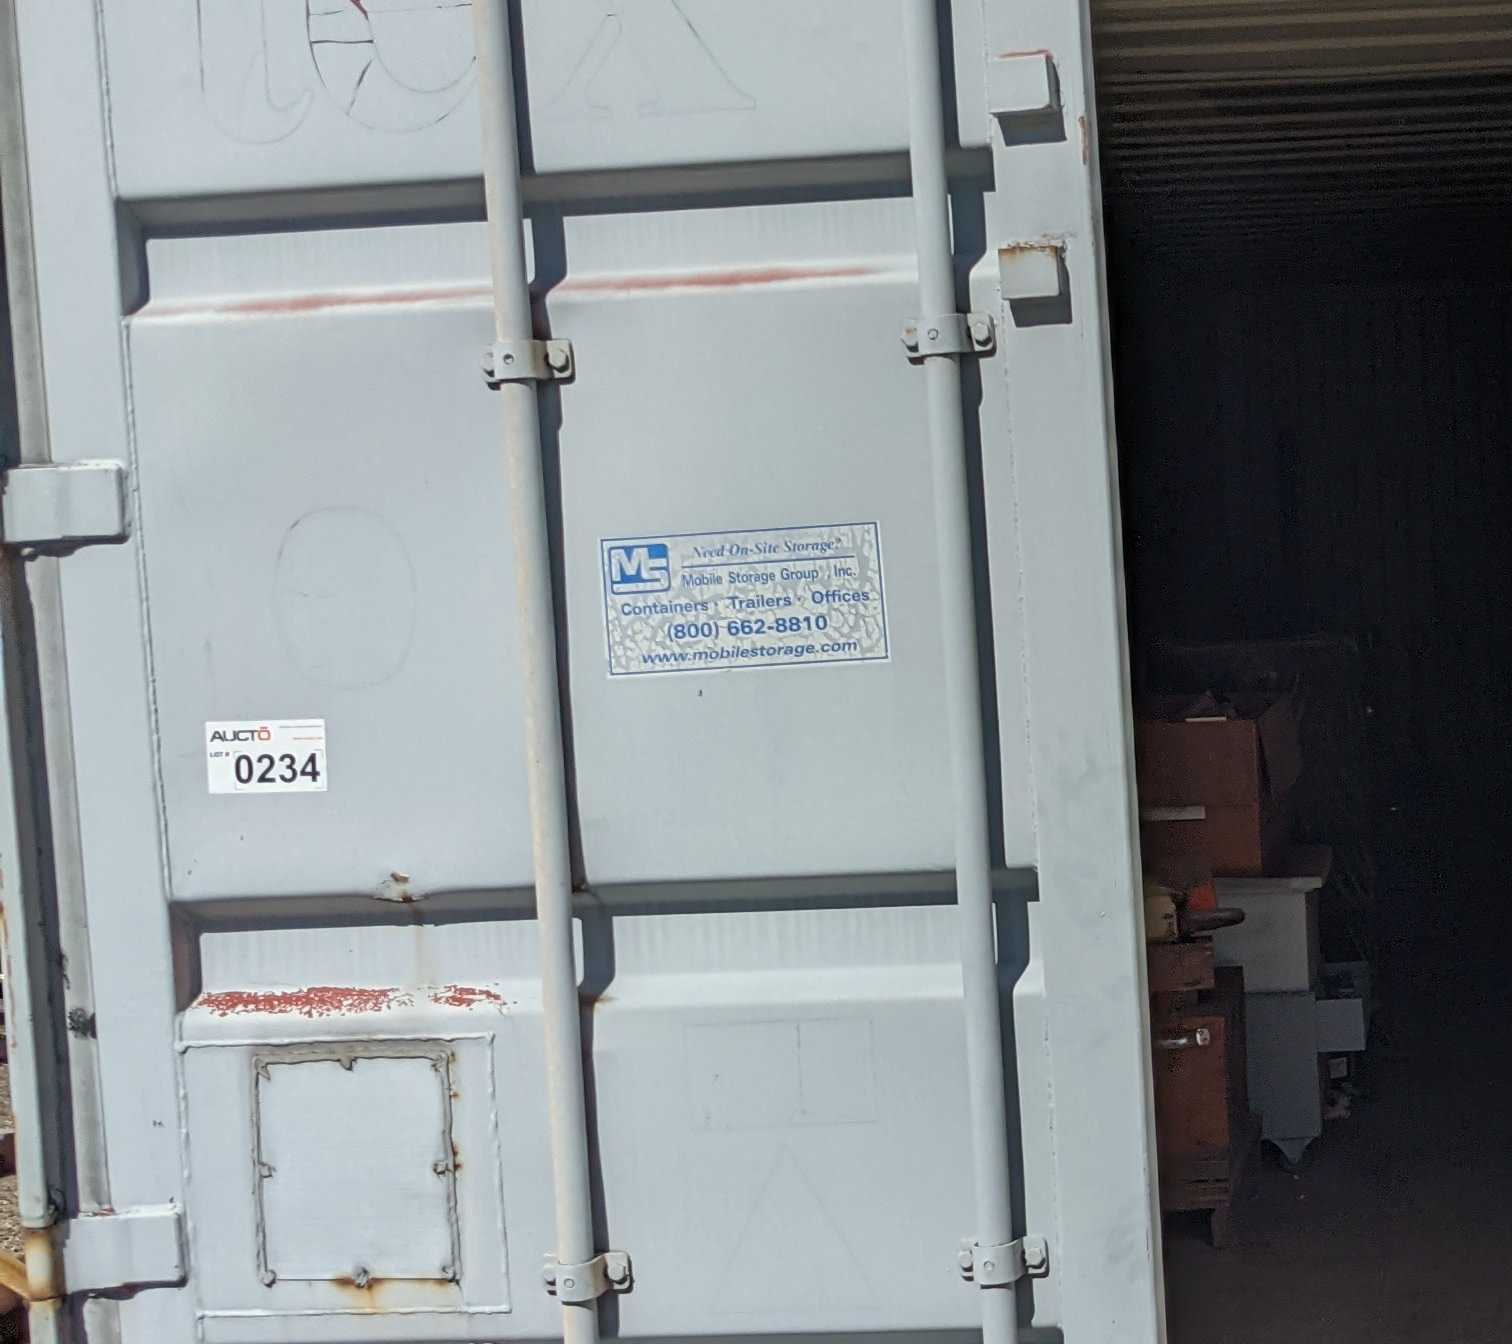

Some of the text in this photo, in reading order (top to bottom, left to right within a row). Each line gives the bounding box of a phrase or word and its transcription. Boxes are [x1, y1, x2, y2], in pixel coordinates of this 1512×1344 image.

[692, 543, 724, 558] Need
[728, 541, 780, 556] On-Site
[681, 573, 723, 587] Mobile
[728, 569, 777, 584] Storage
[833, 564, 857, 578] Inc.
[621, 590, 870, 616] Containers Trailers Offices
[667, 614, 828, 642] (800) 662-8810
[641, 639, 858, 664] www.mobilestorage.com
[235, 752, 320, 784] 0234
